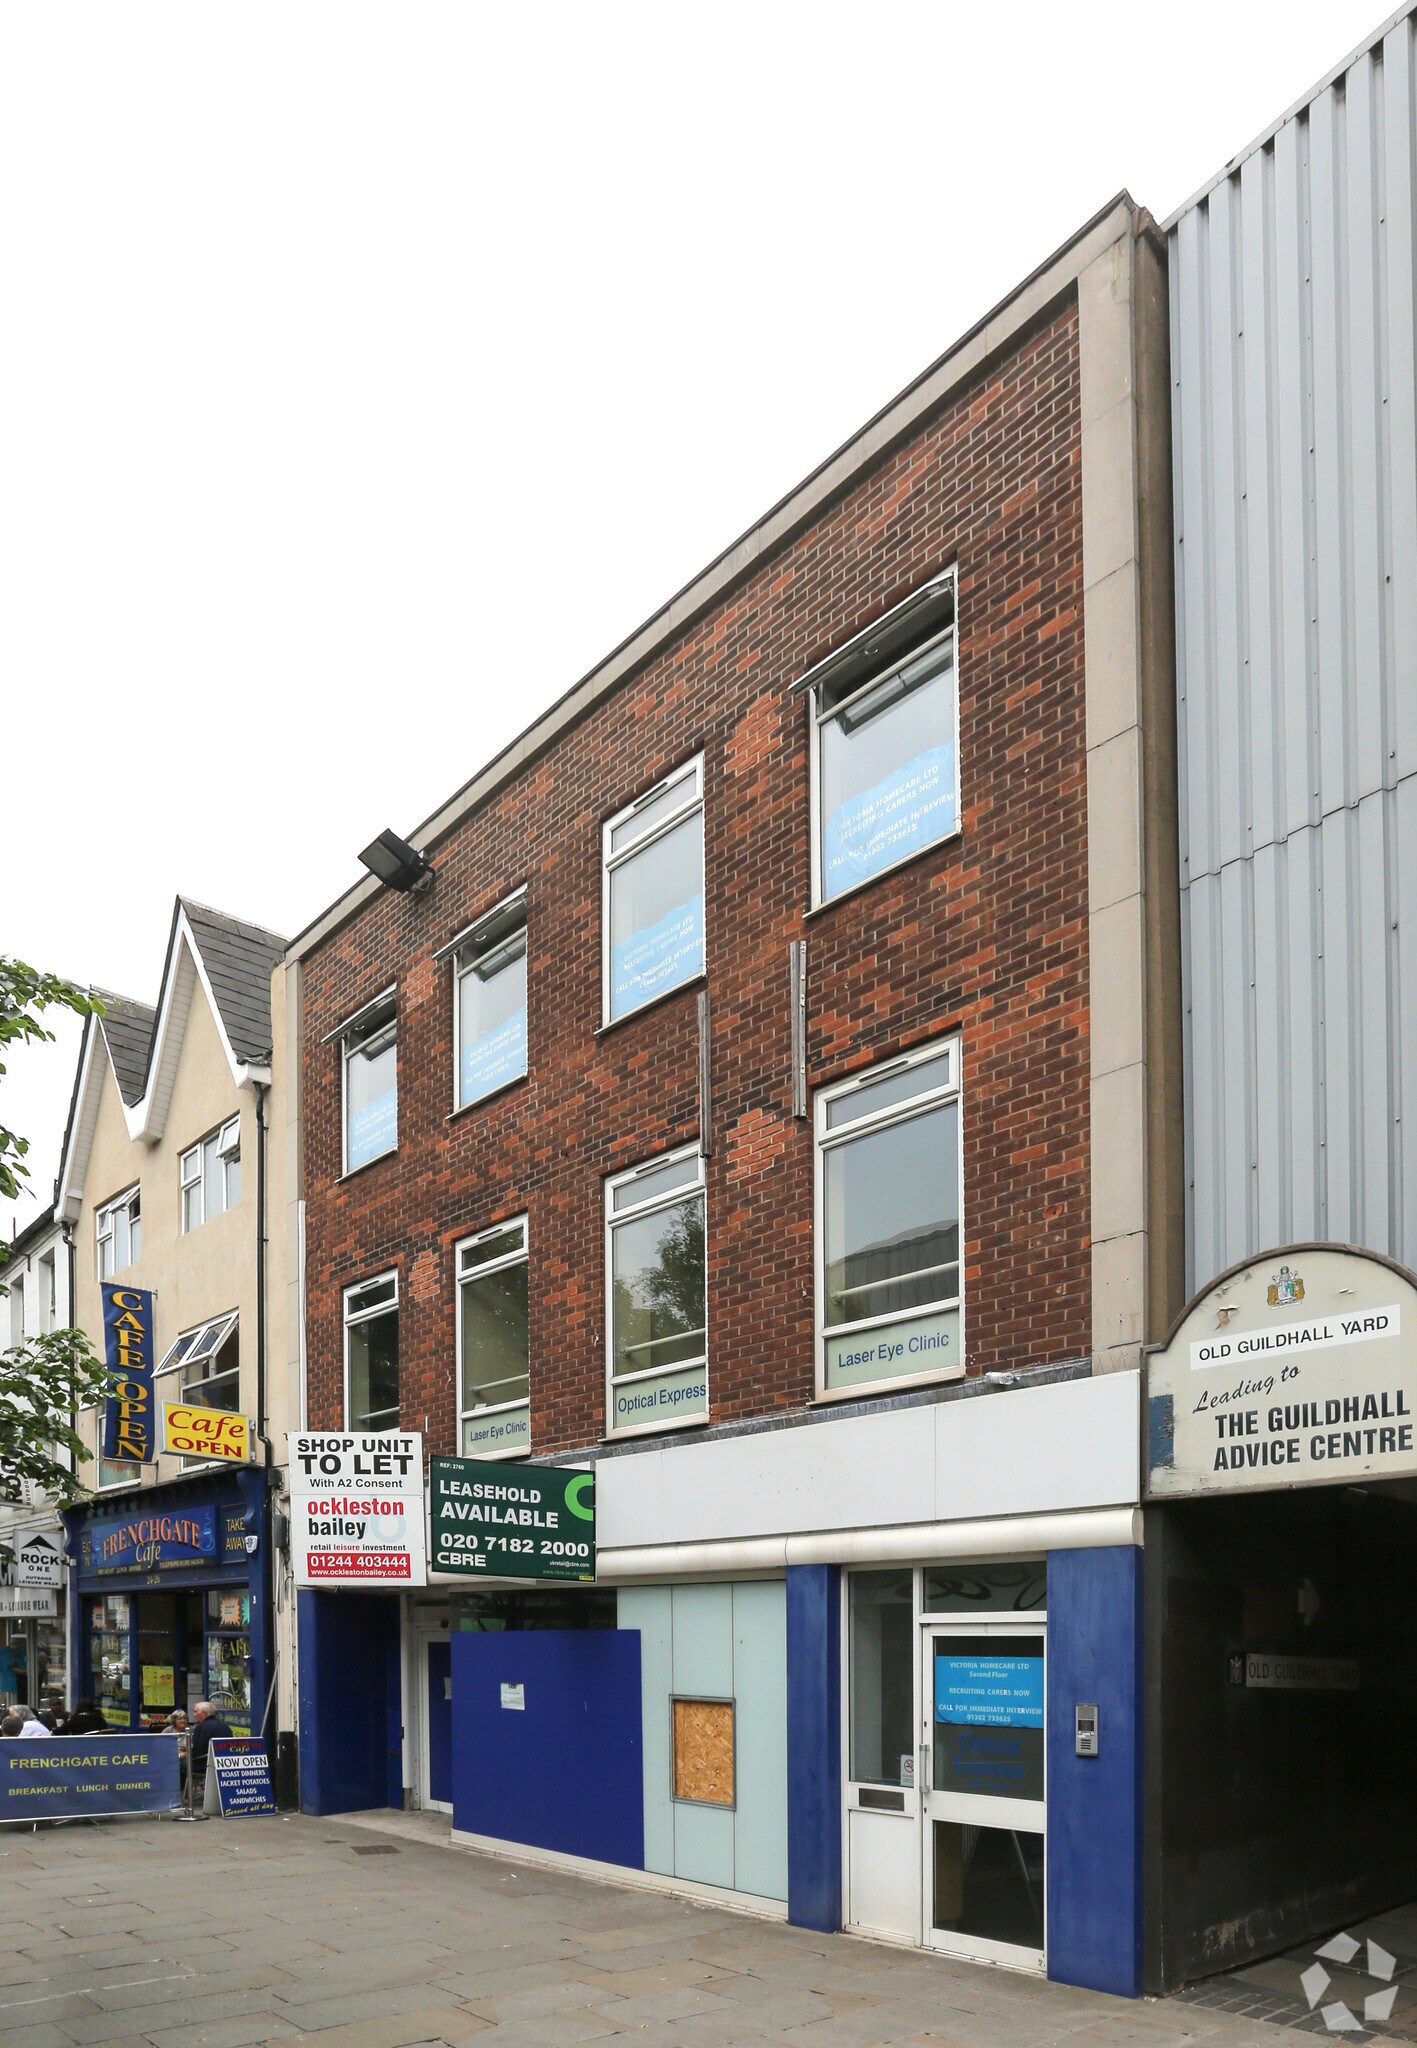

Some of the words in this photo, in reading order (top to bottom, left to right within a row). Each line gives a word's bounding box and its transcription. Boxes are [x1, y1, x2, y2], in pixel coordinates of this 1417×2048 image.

[876, 776, 921, 807] HOMECARE
[923, 765, 939, 779] LTD
[886, 790, 917, 813] CARERS
[919, 775, 940, 793] NOW
[828, 855, 845, 870] CALL
[848, 846, 864, 858] FOR
[866, 816, 908, 849] IMMEDIATE
[112, 1291, 146, 1370] CAFE
[1199, 1344, 1231, 1361] OLD
[1237, 1326, 1334, 1354] GUILDHALL
[1341, 1315, 1388, 1336] YARD
[838, 1349, 875, 1368] Laser
[878, 1343, 904, 1362] Eye
[908, 1332, 949, 1353] Clinic
[1193, 1374, 1276, 1414] Leading
[1281, 1364, 1302, 1382] to
[618, 1391, 657, 1415] Optical
[659, 1383, 706, 1404] Express
[116, 1381, 148, 1461] OPEN
[1215, 1409, 1259, 1439] THE
[1267, 1389, 1411, 1433] GUILDHALL
[168, 1410, 244, 1440] Cafe
[470, 1428, 489, 1442] Laser
[490, 1423, 504, 1439] Eye
[505, 1420, 527, 1434] Clinic
[172, 1437, 241, 1458] OPEN
[297, 1439, 355, 1453] SHOP
[362, 1439, 413, 1453] UNIT
[1213, 1438, 1300, 1471] ADVICE
[1310, 1424, 1413, 1460] CENTRE
[298, 1454, 342, 1475] TO
[354, 1454, 413, 1475] LET
[310, 1478, 335, 1488] With
[337, 1479, 352, 1488] A2
[355, 1479, 403, 1488] Consent
[439, 1480, 541, 1503] LEASEHOLD
[307, 1497, 404, 1516] ockleston
[440, 1501, 559, 1528] AVAILABLE
[226, 1517, 245, 1532] TAKE
[308, 1518, 366, 1540] bailey
[82, 1541, 91, 1554] EAT
[103, 1517, 200, 1561] FRENCHGATE
[226, 1537, 246, 1551] AWAY
[440, 1533, 478, 1549] 020
[484, 1536, 534, 1553] 7182
[540, 1540, 589, 1557] 2000
[21, 1553, 59, 1566] ROCK
[135, 1539, 161, 1568] Cafe
[310, 1556, 353, 1567] 01244
[356, 1556, 408, 1567] 403444
[436, 1552, 486, 1567] CBRE
[311, 1569, 408, 1577] www.ocklestonbailey.co.uk
[9, 1600, 31, 1611] LESURE
[33, 1600, 49, 1611] WEAR
[969, 1670, 991, 1678] Second
[1248, 1662, 1270, 1679] OLD
[1274, 1664, 1326, 1680] GUILDHALL
[949, 1687, 985, 1695] RECRUITING
[969, 1705, 1004, 1713] IMMEDIATE
[229, 1746, 250, 1754] Cafe
[958, 1733, 1020, 1756] Optical
[9, 1756, 108, 1769] FRENCHGATE
[111, 1754, 149, 1766] CAFE
[216, 1757, 240, 1768] NOW
[242, 1756, 267, 1767] OPEN
[953, 1754, 1023, 1779] Express
[220, 1779, 241, 1787] JACKET
[242, 1778, 270, 1786] POTATOES
[221, 1770, 240, 1778] ROAST
[240, 1769, 266, 1777] DINNERS
[8, 1785, 69, 1796] BREAKFAST
[76, 1784, 109, 1793] LUNCH
[116, 1781, 151, 1791] DINNER
[236, 1787, 257, 1795] SALADS
[225, 1807, 248, 1816] Served
[250, 1804, 260, 1812] all
[229, 1796, 266, 1805] SANDWICHES
